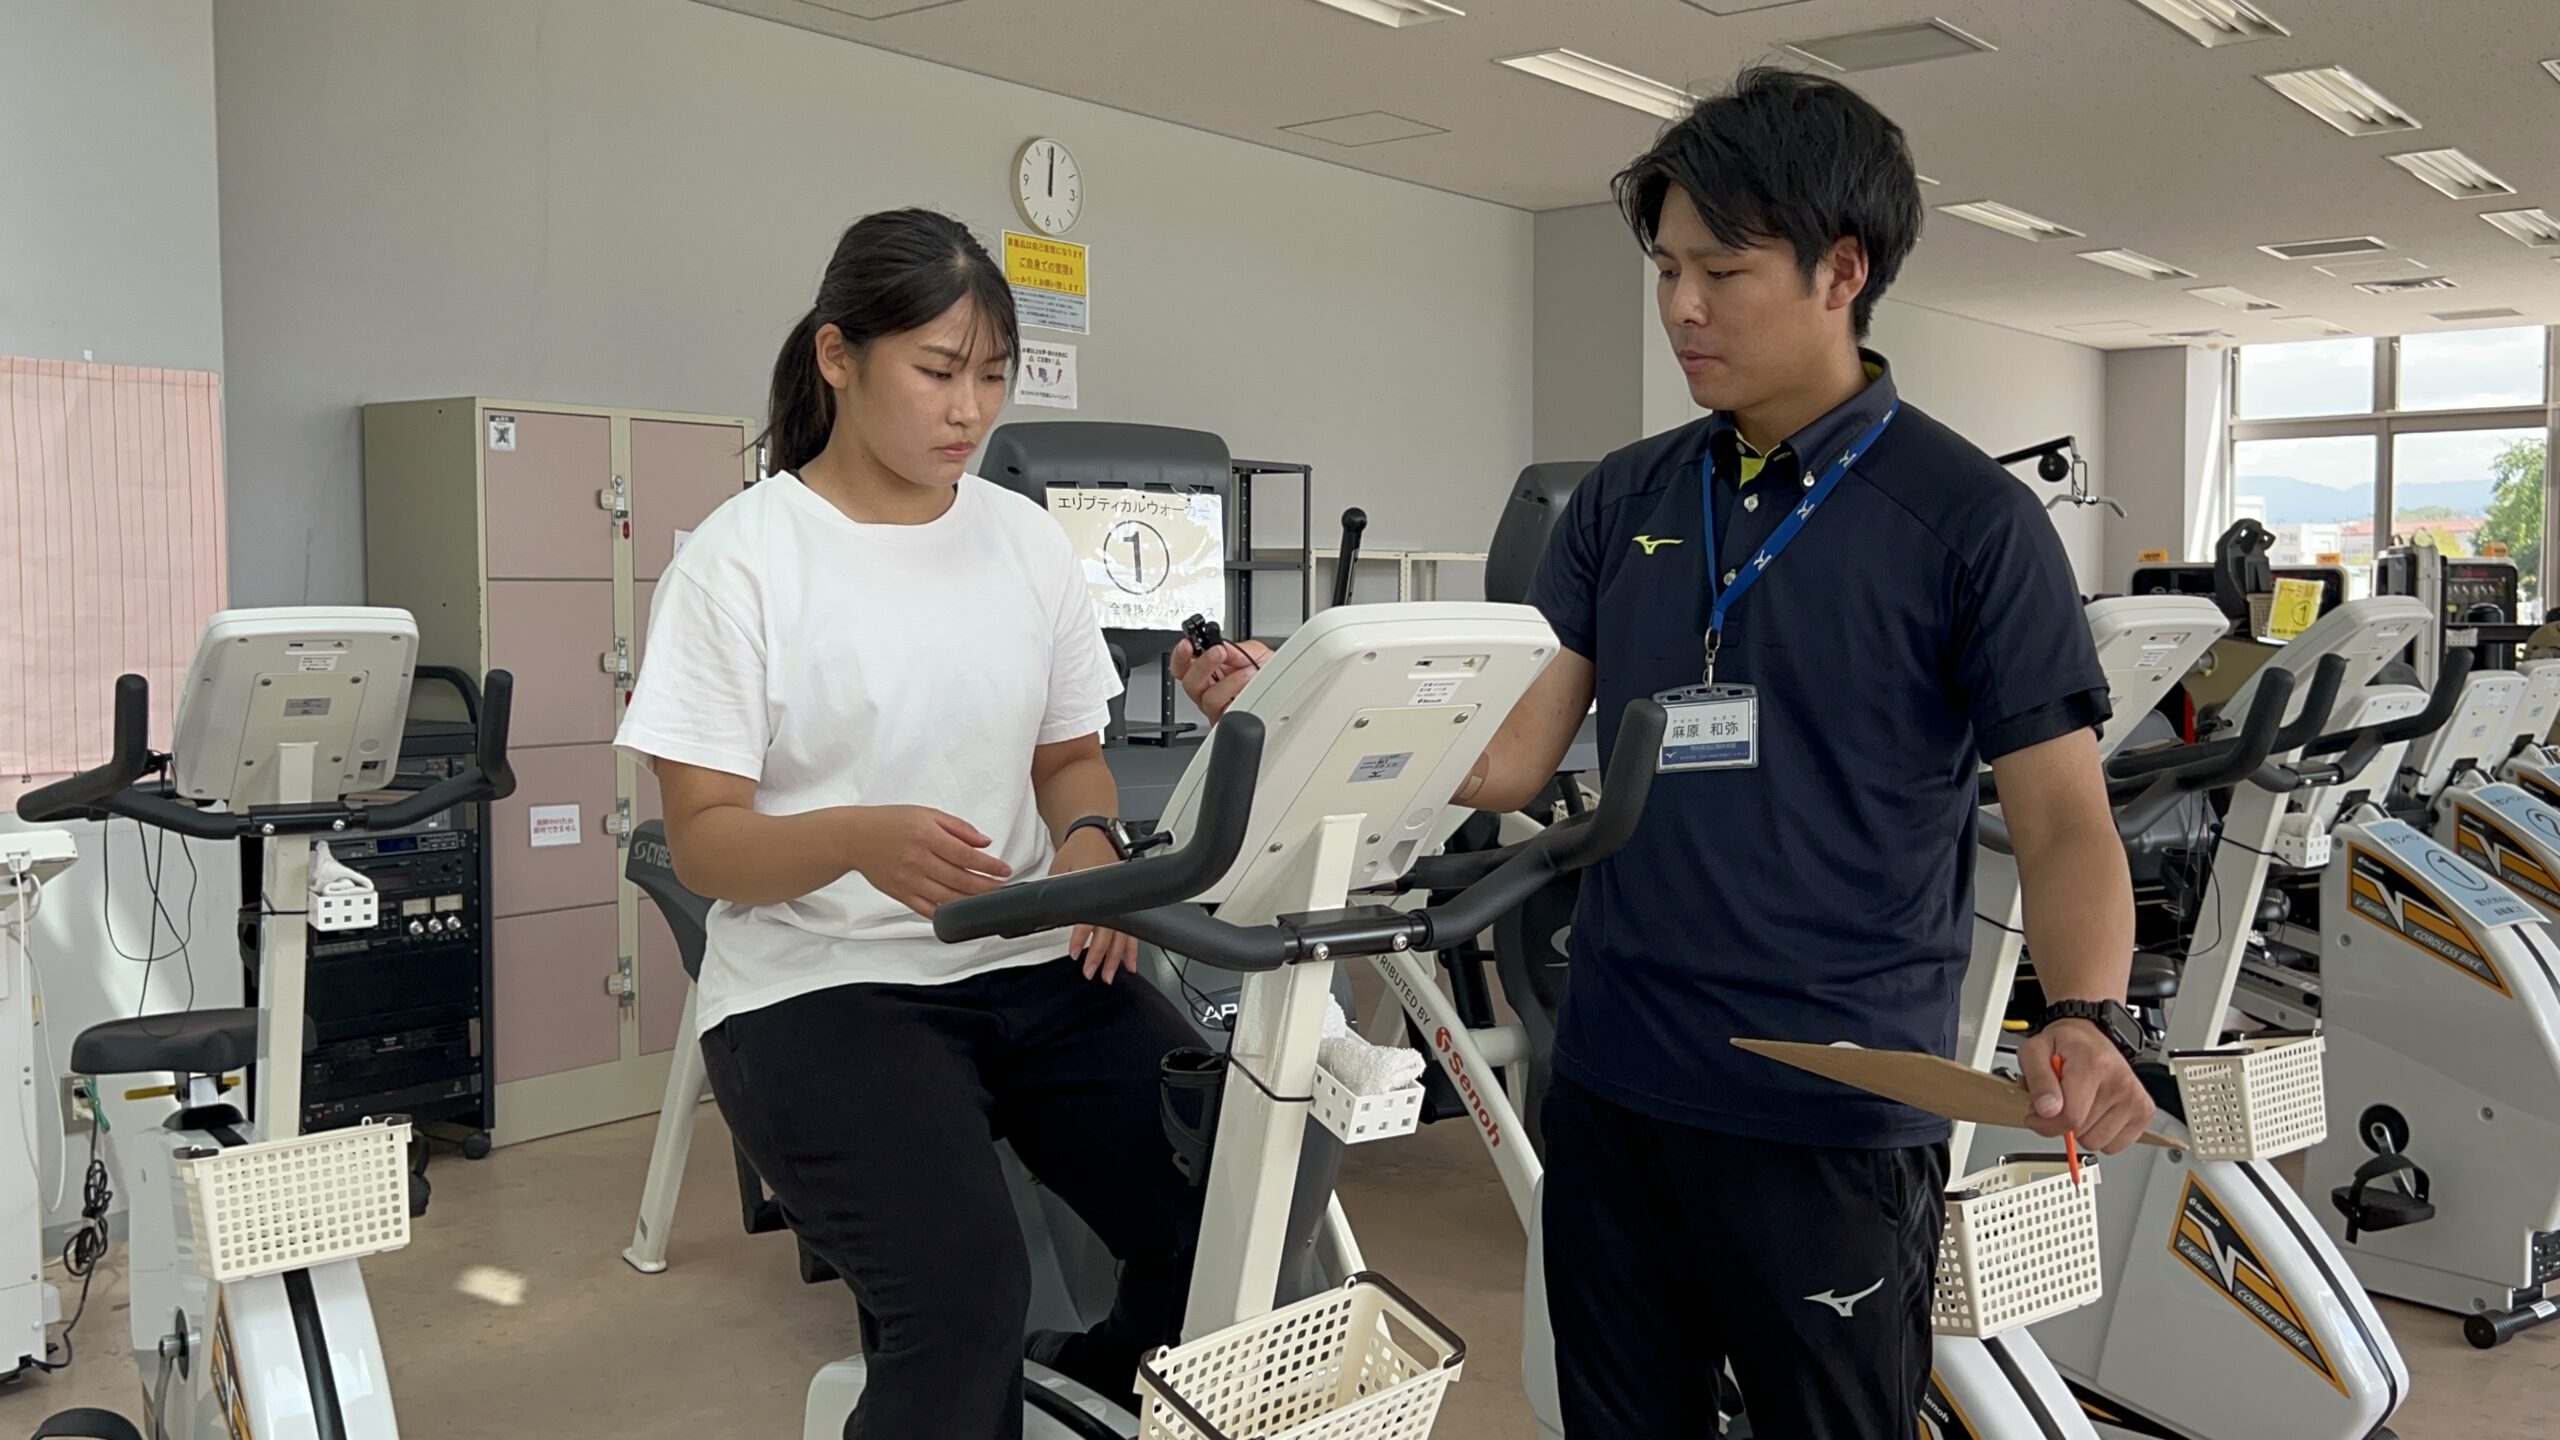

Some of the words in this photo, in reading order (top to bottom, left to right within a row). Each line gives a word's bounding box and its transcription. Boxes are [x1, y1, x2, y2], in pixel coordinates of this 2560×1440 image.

[1023, 174, 1029, 186] 9
[1069, 189, 1075, 201] 3
[1045, 215, 1050, 226] 6
[1058, 496, 1210, 516] エリプティカルウォーカー
[1672, 724, 1700, 739] 麻原
[1710, 721, 1740, 737] 和弥
[646, 842, 672, 869] CYBE
[2413, 930, 2460, 958] CORDLESS
[2458, 954, 2482, 970] BIKE
[1417, 1006, 1431, 1025] BY
[1449, 1051, 1500, 1148] Senoh
[2194, 1202, 2221, 1228] Senoh
[2178, 1239, 2189, 1248] V
[2185, 1245, 2214, 1271] Series
[2236, 1289, 2286, 1330] CORDLESS
[2283, 1327, 2309, 1348] BIKE
